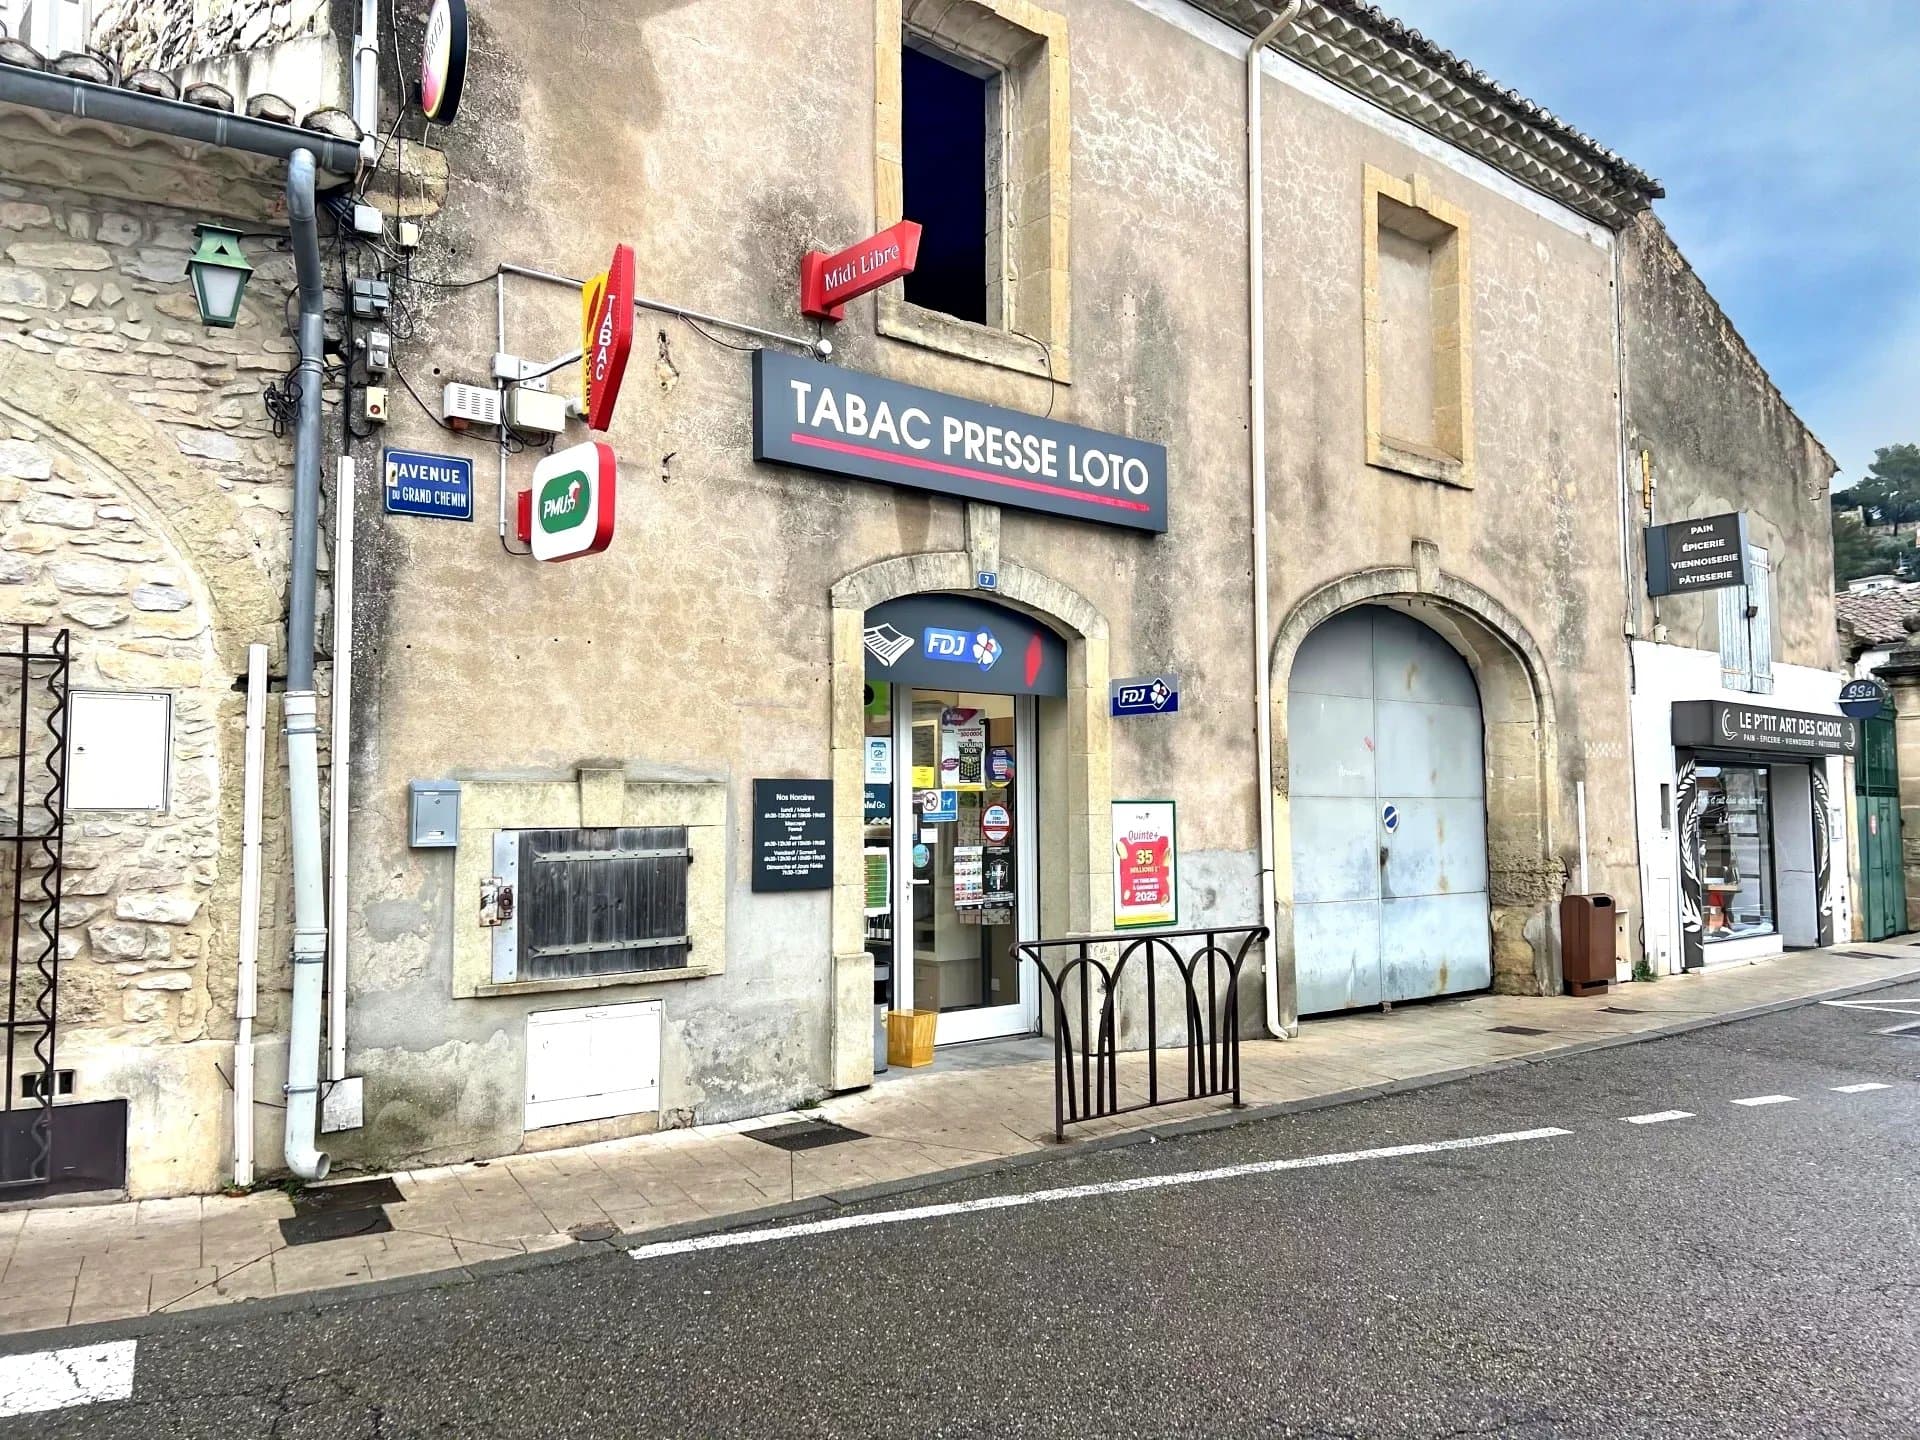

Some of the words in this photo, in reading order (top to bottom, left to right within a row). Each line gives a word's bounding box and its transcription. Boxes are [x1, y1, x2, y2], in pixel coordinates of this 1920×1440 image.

[824, 260, 857, 291] Midi
[860, 245, 899, 274] Libre
[595, 295, 616, 381] TABAC
[790, 379, 931, 450] TABAC
[943, 416, 1057, 478] PRESSE
[1069, 444, 1149, 495] LOTO
[399, 463, 461, 484] AVENUE
[392, 490, 400, 500] DU
[402, 486, 432, 504] GRAND
[434, 490, 467, 508] CHEMIN
[543, 495, 569, 519] PMU
[1690, 524, 1714, 534] PAIN
[1682, 538, 1725, 552] ÉPICERIE
[1671, 553, 1739, 570] VIENNOISERIE
[984, 575, 990, 584] 7
[1679, 571, 1733, 584] PÂTISSERIE
[927, 633, 966, 656] FDJ
[1121, 689, 1146, 703] FDJ
[1739, 711, 1751, 729] LE
[1754, 713, 1777, 731] P'TIT
[1779, 718, 1797, 733] ART
[1799, 719, 1815, 735] DES
[1817, 721, 1842, 738] CHOIX
[1743, 733, 1756, 742] PAIN
[775, 793, 789, 801] Nos
[1135, 849, 1154, 865] 35
[1135, 891, 1158, 902] 2025
